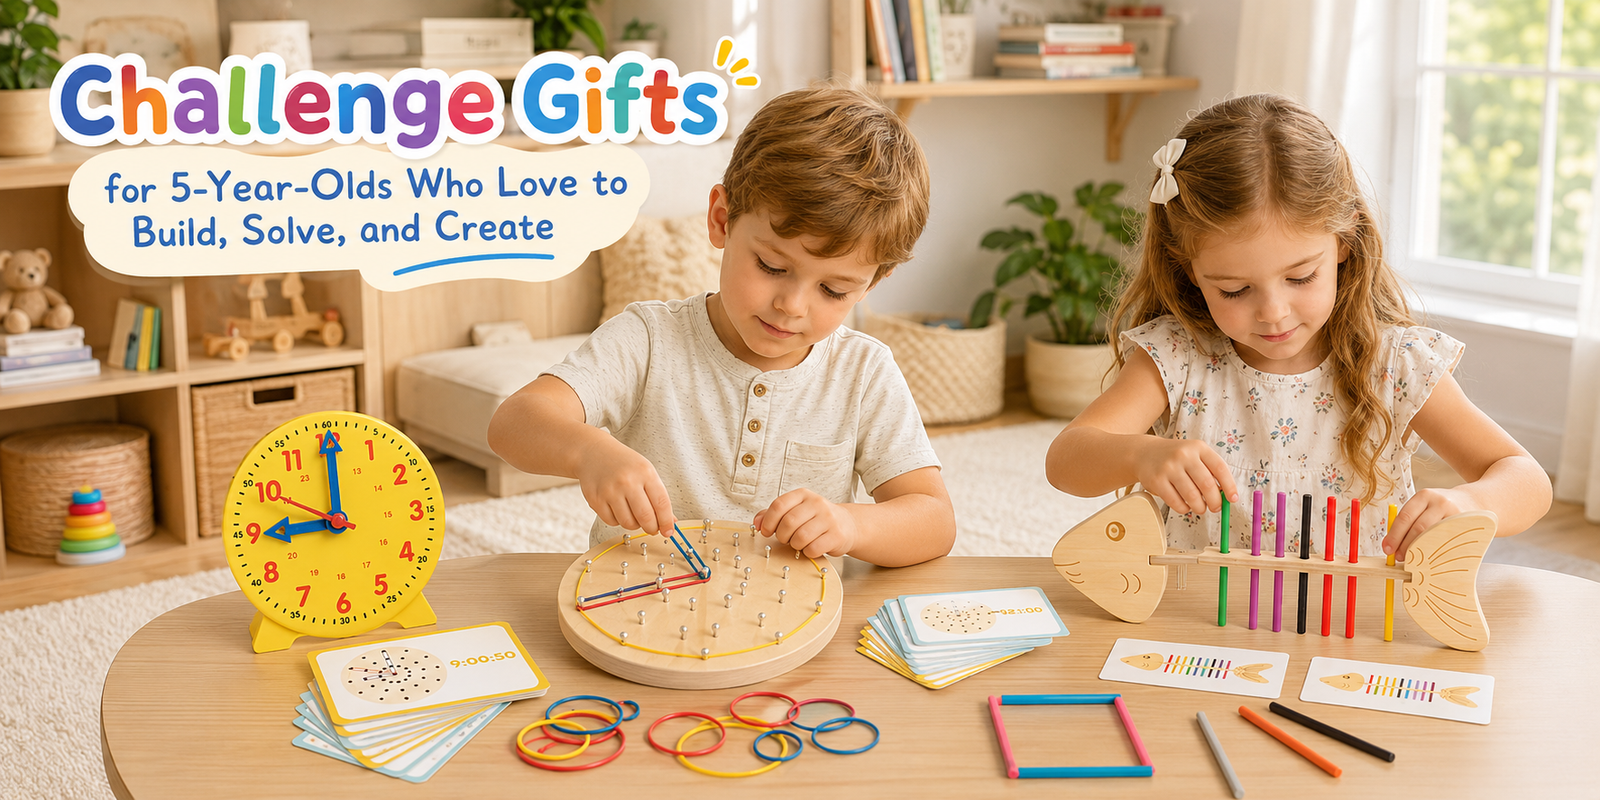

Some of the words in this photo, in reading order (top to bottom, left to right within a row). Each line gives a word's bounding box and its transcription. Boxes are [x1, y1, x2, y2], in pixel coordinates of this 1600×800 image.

[321, 420, 332, 429] 60
[373, 428, 379, 436] 5
[274, 439, 285, 448] 55
[364, 439, 375, 461] 1
[281, 449, 302, 472] 11
[408, 458, 418, 466] 10
[352, 467, 362, 475] 13
[392, 463, 408, 486] 2
[299, 474, 310, 483] 23
[243, 479, 254, 488] 50
[373, 484, 383, 492] 14
[254, 479, 283, 504] 10
[409, 499, 424, 522] 3
[426, 505, 435, 513] 15
[383, 510, 393, 518] 15
[233, 530, 244, 539] 45
[245, 522, 261, 545] 9
[379, 538, 389, 546] 16
[287, 551, 298, 560] 20
[398, 540, 415, 563] 4
[417, 555, 428, 564] 20
[362, 560, 371, 569] 17
[263, 560, 280, 584] 8
[309, 568, 319, 577] 19
[251, 578, 262, 587] 40
[374, 573, 389, 596] 5
[295, 584, 312, 608] 7
[386, 594, 397, 603] 25
[336, 591, 352, 614] 6
[290, 610, 301, 619] 35
[340, 616, 351, 625] 30
[450, 651, 516, 668] 9:00:50
